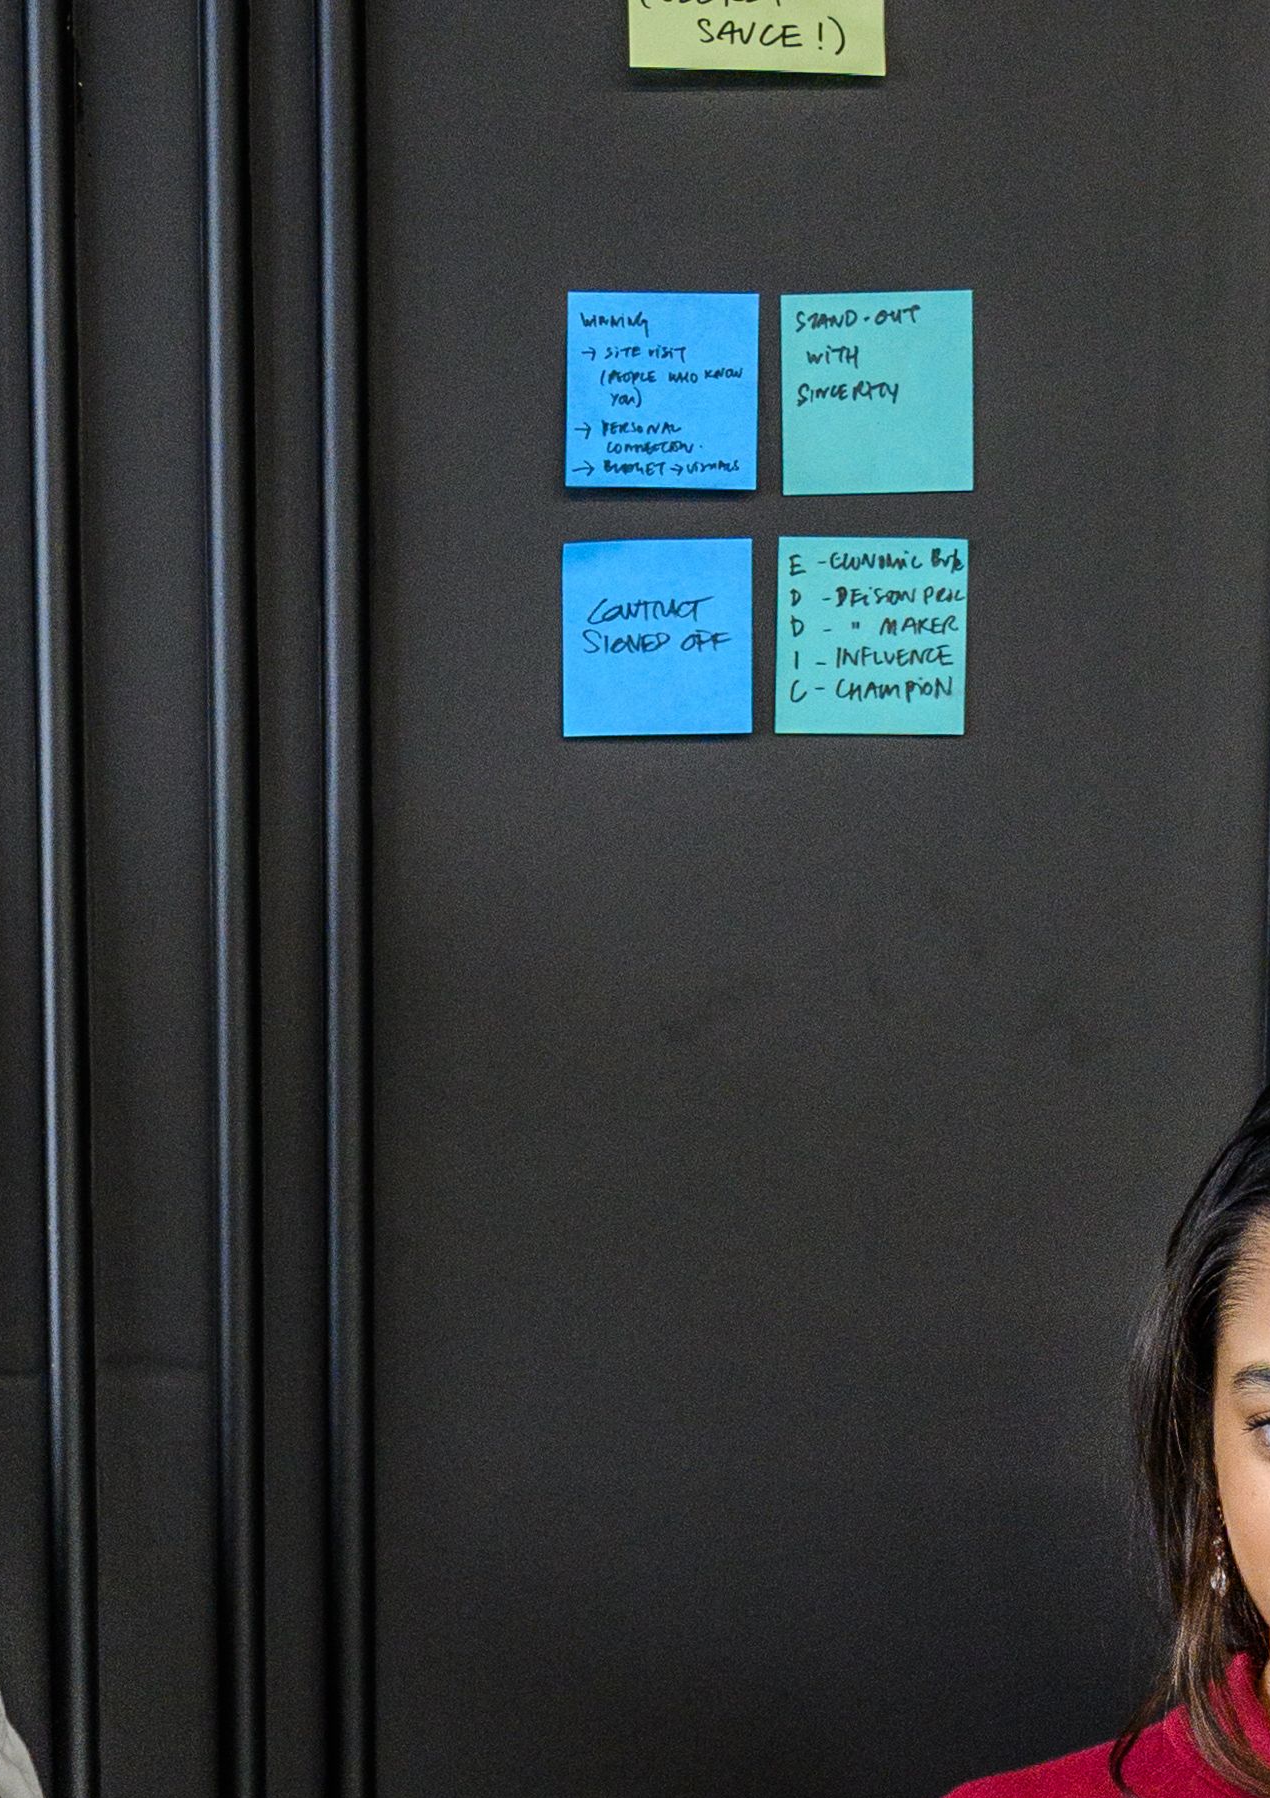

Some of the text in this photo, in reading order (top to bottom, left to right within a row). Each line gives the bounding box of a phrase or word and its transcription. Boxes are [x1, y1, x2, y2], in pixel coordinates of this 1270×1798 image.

[603, 346, 641, 360] SITE
[806, 345, 859, 369] WITH
[704, 367, 744, 380] KNOW
[601, 420, 682, 437] PERSONAL
[789, 553, 807, 577] E
[789, 587, 802, 607] D
[586, 596, 715, 625] CONTRACT
[790, 614, 959, 637] D MAKER
[836, 644, 954, 669] INFLUENCE
[789, 675, 953, 703] C CHAMPION
